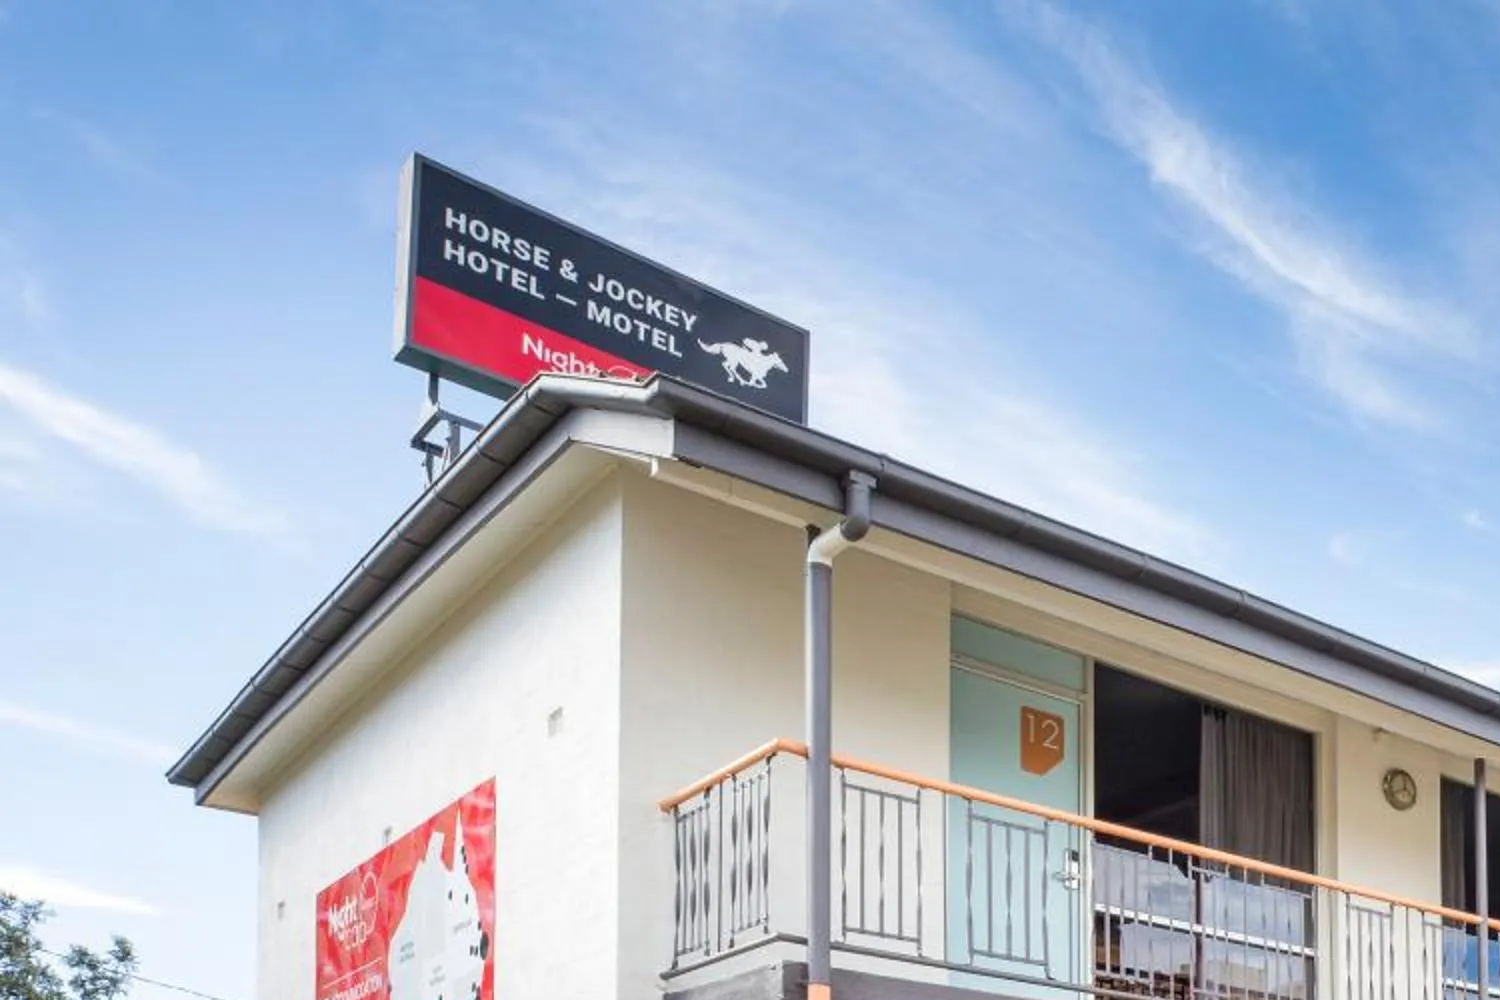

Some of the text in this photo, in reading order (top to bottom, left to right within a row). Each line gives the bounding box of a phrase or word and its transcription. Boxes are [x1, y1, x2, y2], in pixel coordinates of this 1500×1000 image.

[443, 238, 546, 301] HOTEL
[586, 298, 683, 358] MOTEL
[444, 206, 698, 333] HORSE & JOCKEY
[1027, 714, 1060, 750] 12
